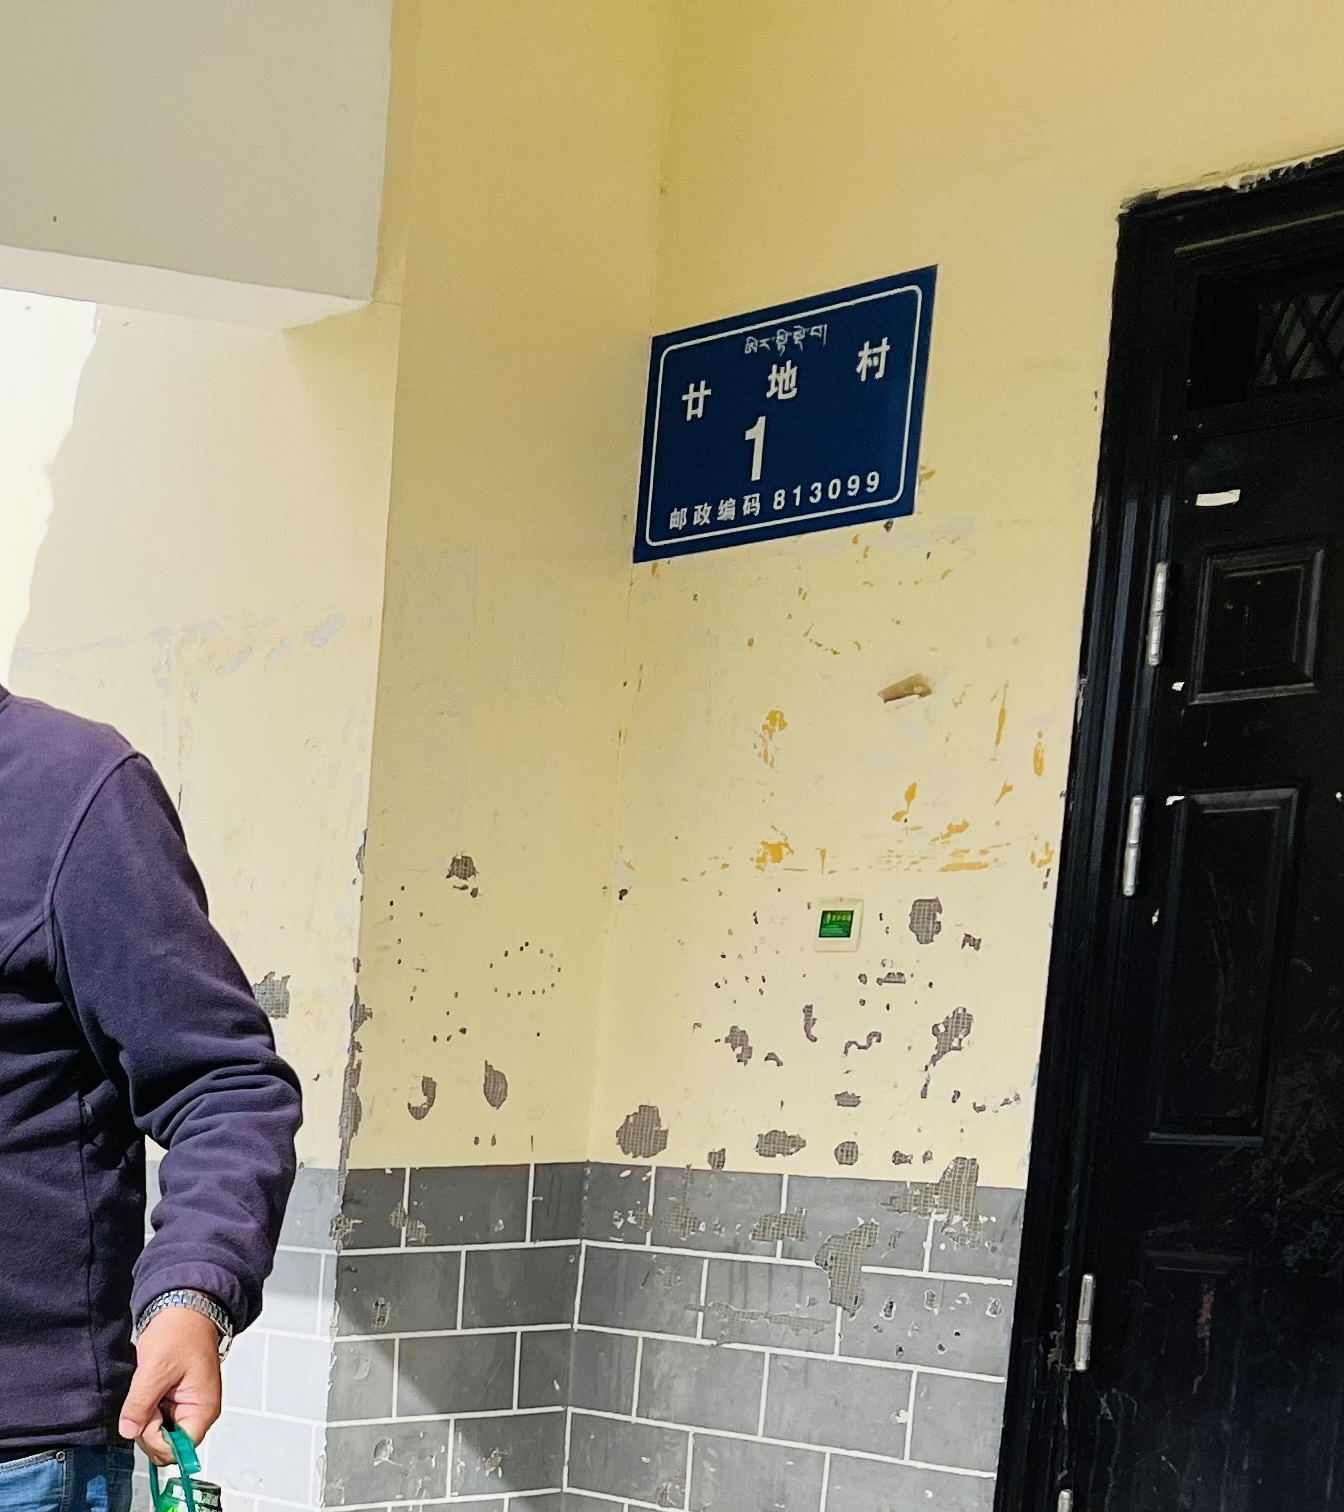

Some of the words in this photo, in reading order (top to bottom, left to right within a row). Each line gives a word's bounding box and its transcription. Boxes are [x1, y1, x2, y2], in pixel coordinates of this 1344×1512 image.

[744, 415, 767, 482] 1
[668, 492, 762, 530] 邮政编码
[772, 471, 881, 510] 813099
